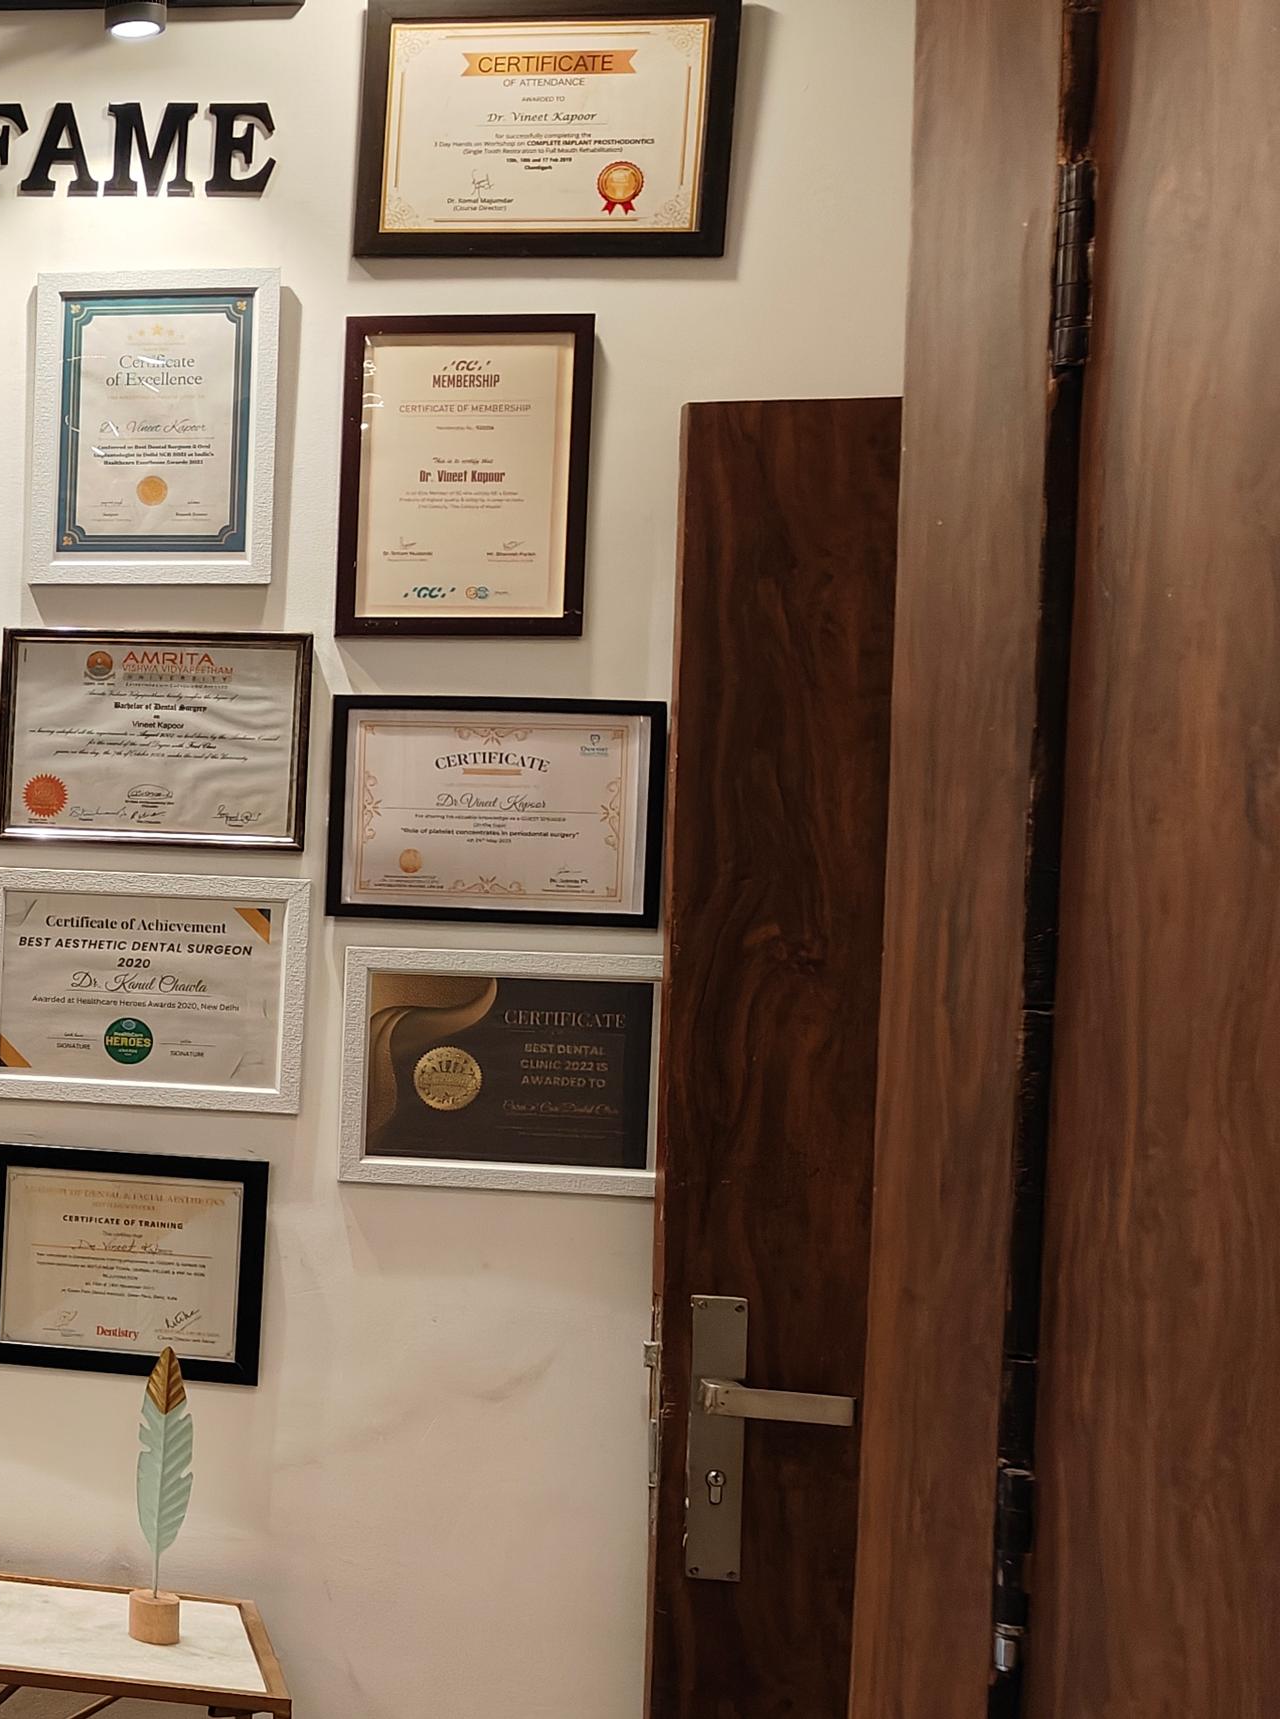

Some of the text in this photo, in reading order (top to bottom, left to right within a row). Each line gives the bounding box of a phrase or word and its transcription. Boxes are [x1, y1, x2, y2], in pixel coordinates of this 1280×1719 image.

[478, 54, 613, 73] CERTIFICATE
[503, 78, 585, 87] OF ATTENDANCE
[512, 112, 597, 124] Vineet Kapoor
[106, 371, 202, 386] of Excellence
[432, 374, 500, 388] MEMBERSHIP
[399, 404, 531, 413] CERTIFICATE OF MEMBERSHIP
[123, 651, 214, 666] AMRITA
[123, 665, 159, 673] VISHWA
[154, 703, 177, 711] Dental
[157, 721, 184, 730] Kapoor
[435, 751, 550, 773] CERTIFICATE
[46, 915, 226, 934] Certificate of Achievement
[19, 936, 253, 957] BEST AESTHETIC DENTAL SURGEON
[117, 957, 151, 969] 2020
[71, 971, 100, 989] Dr.
[32, 995, 176, 1009] Awarded Healthcare Heroes Awards
[504, 1009, 626, 1029] CERTIFICATE
[105, 1037, 151, 1048] HEROES
[524, 1043, 606, 1055] BEST DENTAL
[520, 1059, 594, 1071] CLINIC 2022
[521, 1075, 606, 1088] AWARDED TO
[63, 1214, 120, 1225] CERTIFICATE
[139, 1220, 183, 1230] TRAINING
[96, 1325, 139, 1340] Dentistry
